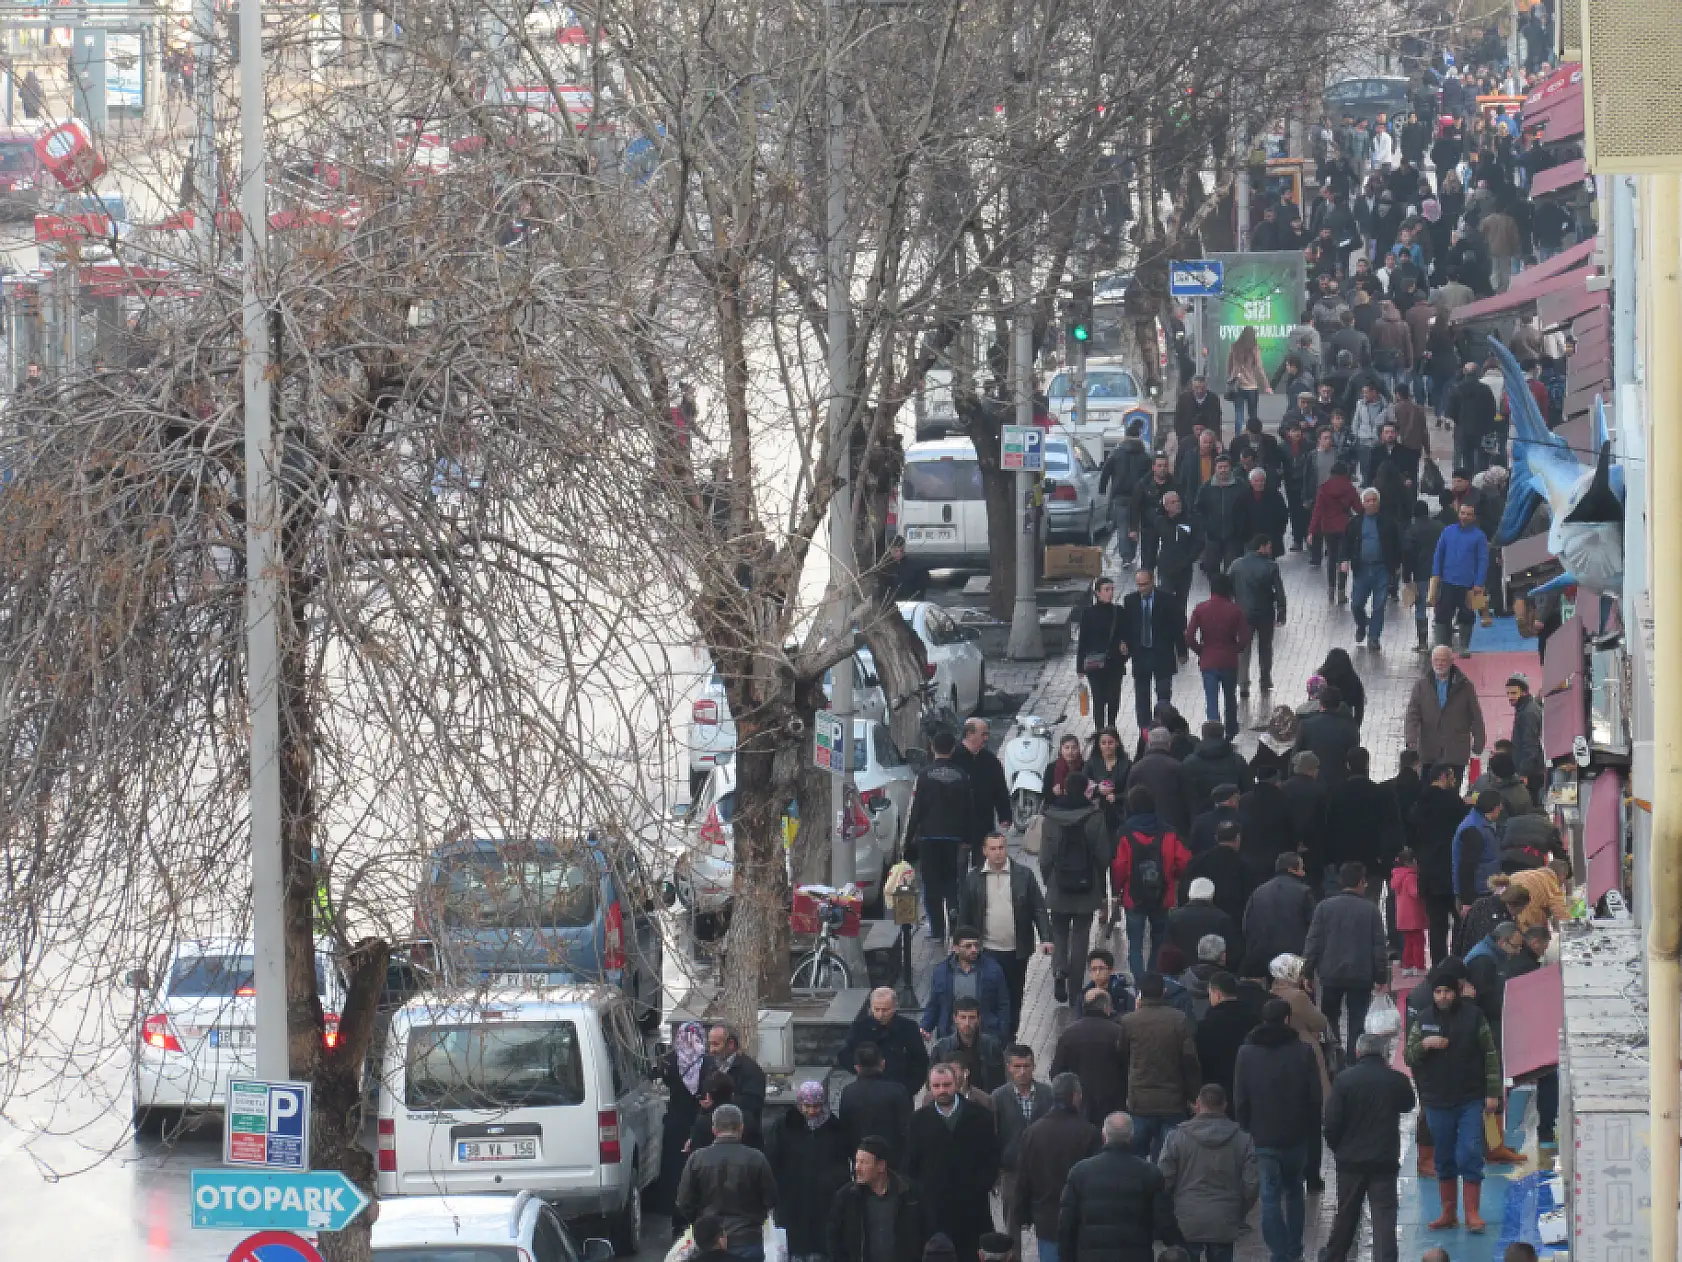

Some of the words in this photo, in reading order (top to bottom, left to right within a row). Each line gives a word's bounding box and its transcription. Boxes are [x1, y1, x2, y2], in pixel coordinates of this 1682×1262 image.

[1024, 431, 1039, 452] P
[831, 722, 842, 749] P
[269, 1090, 299, 1132] P
[196, 1185, 345, 1212] OTOPARK
